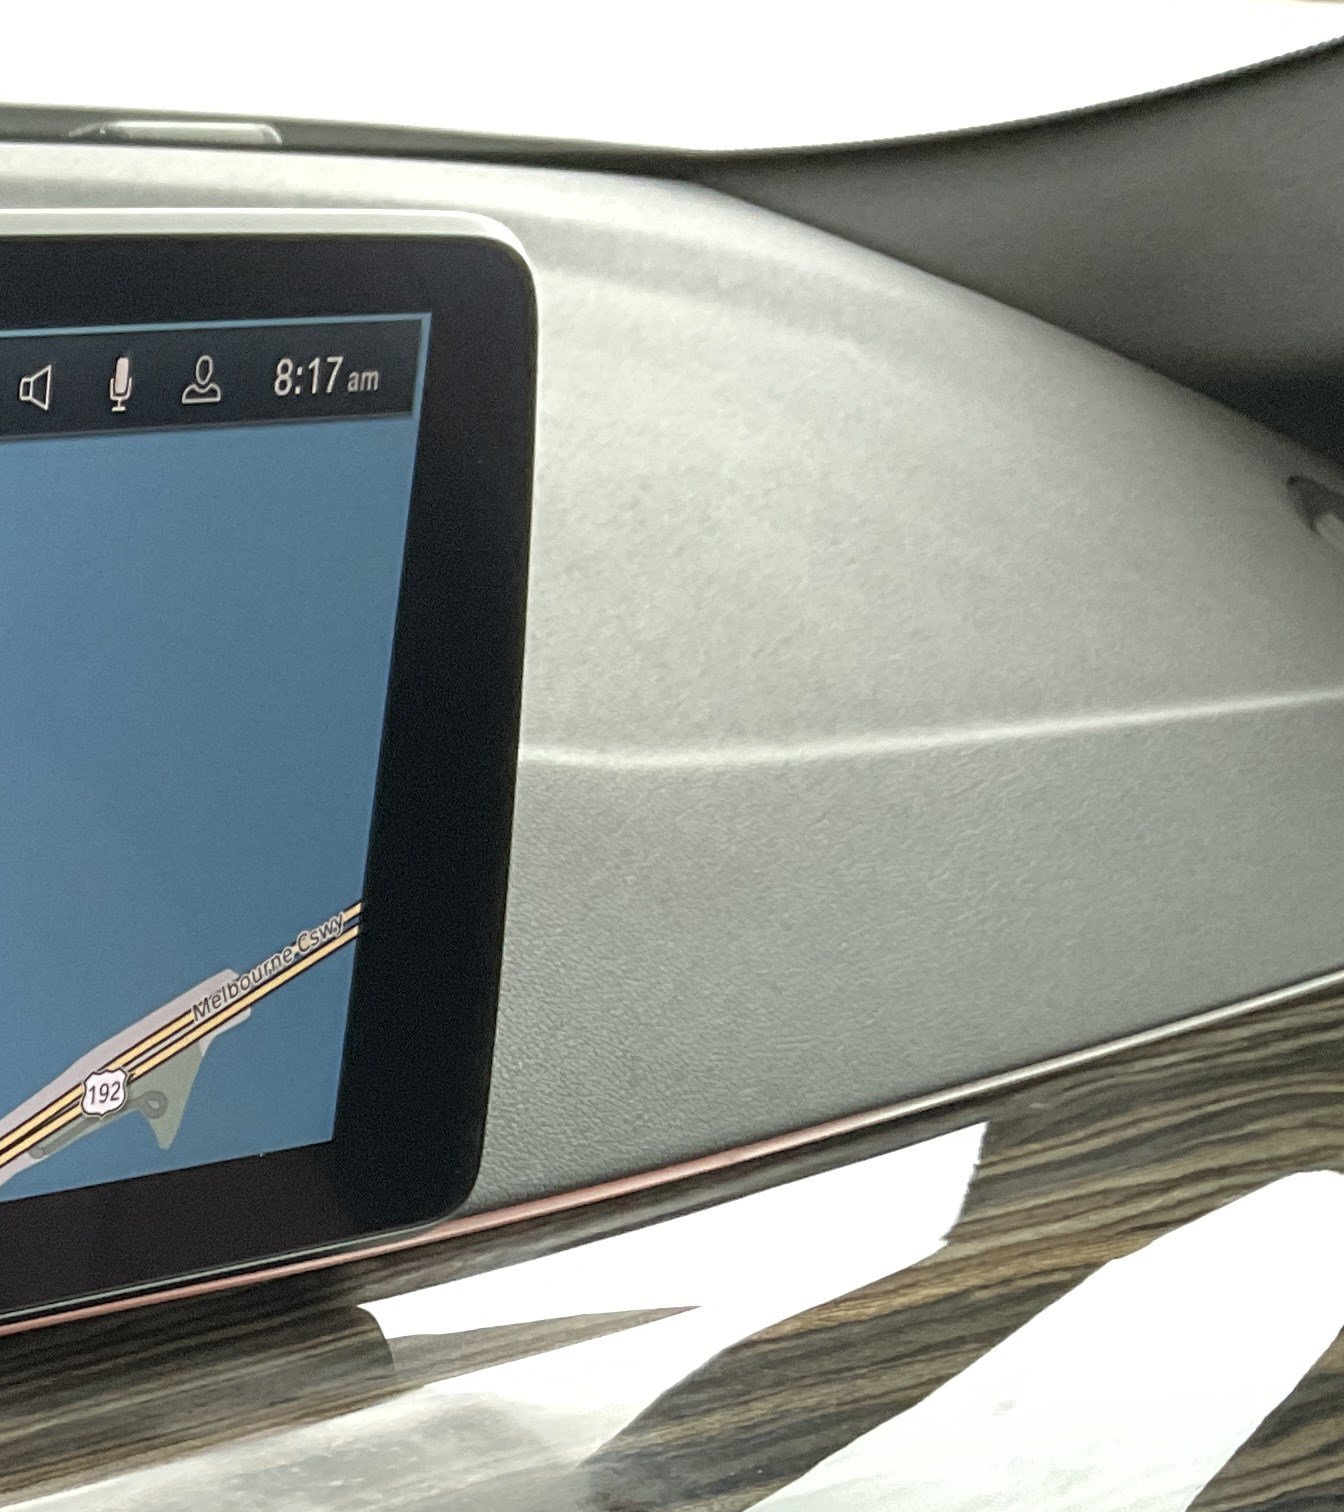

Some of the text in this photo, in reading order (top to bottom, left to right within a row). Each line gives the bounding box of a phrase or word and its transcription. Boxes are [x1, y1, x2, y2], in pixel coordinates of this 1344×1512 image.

[273, 355, 380, 397] 8:17 am
[191, 911, 345, 1022] Melbourne Cswy
[88, 1080, 121, 1106] 192
